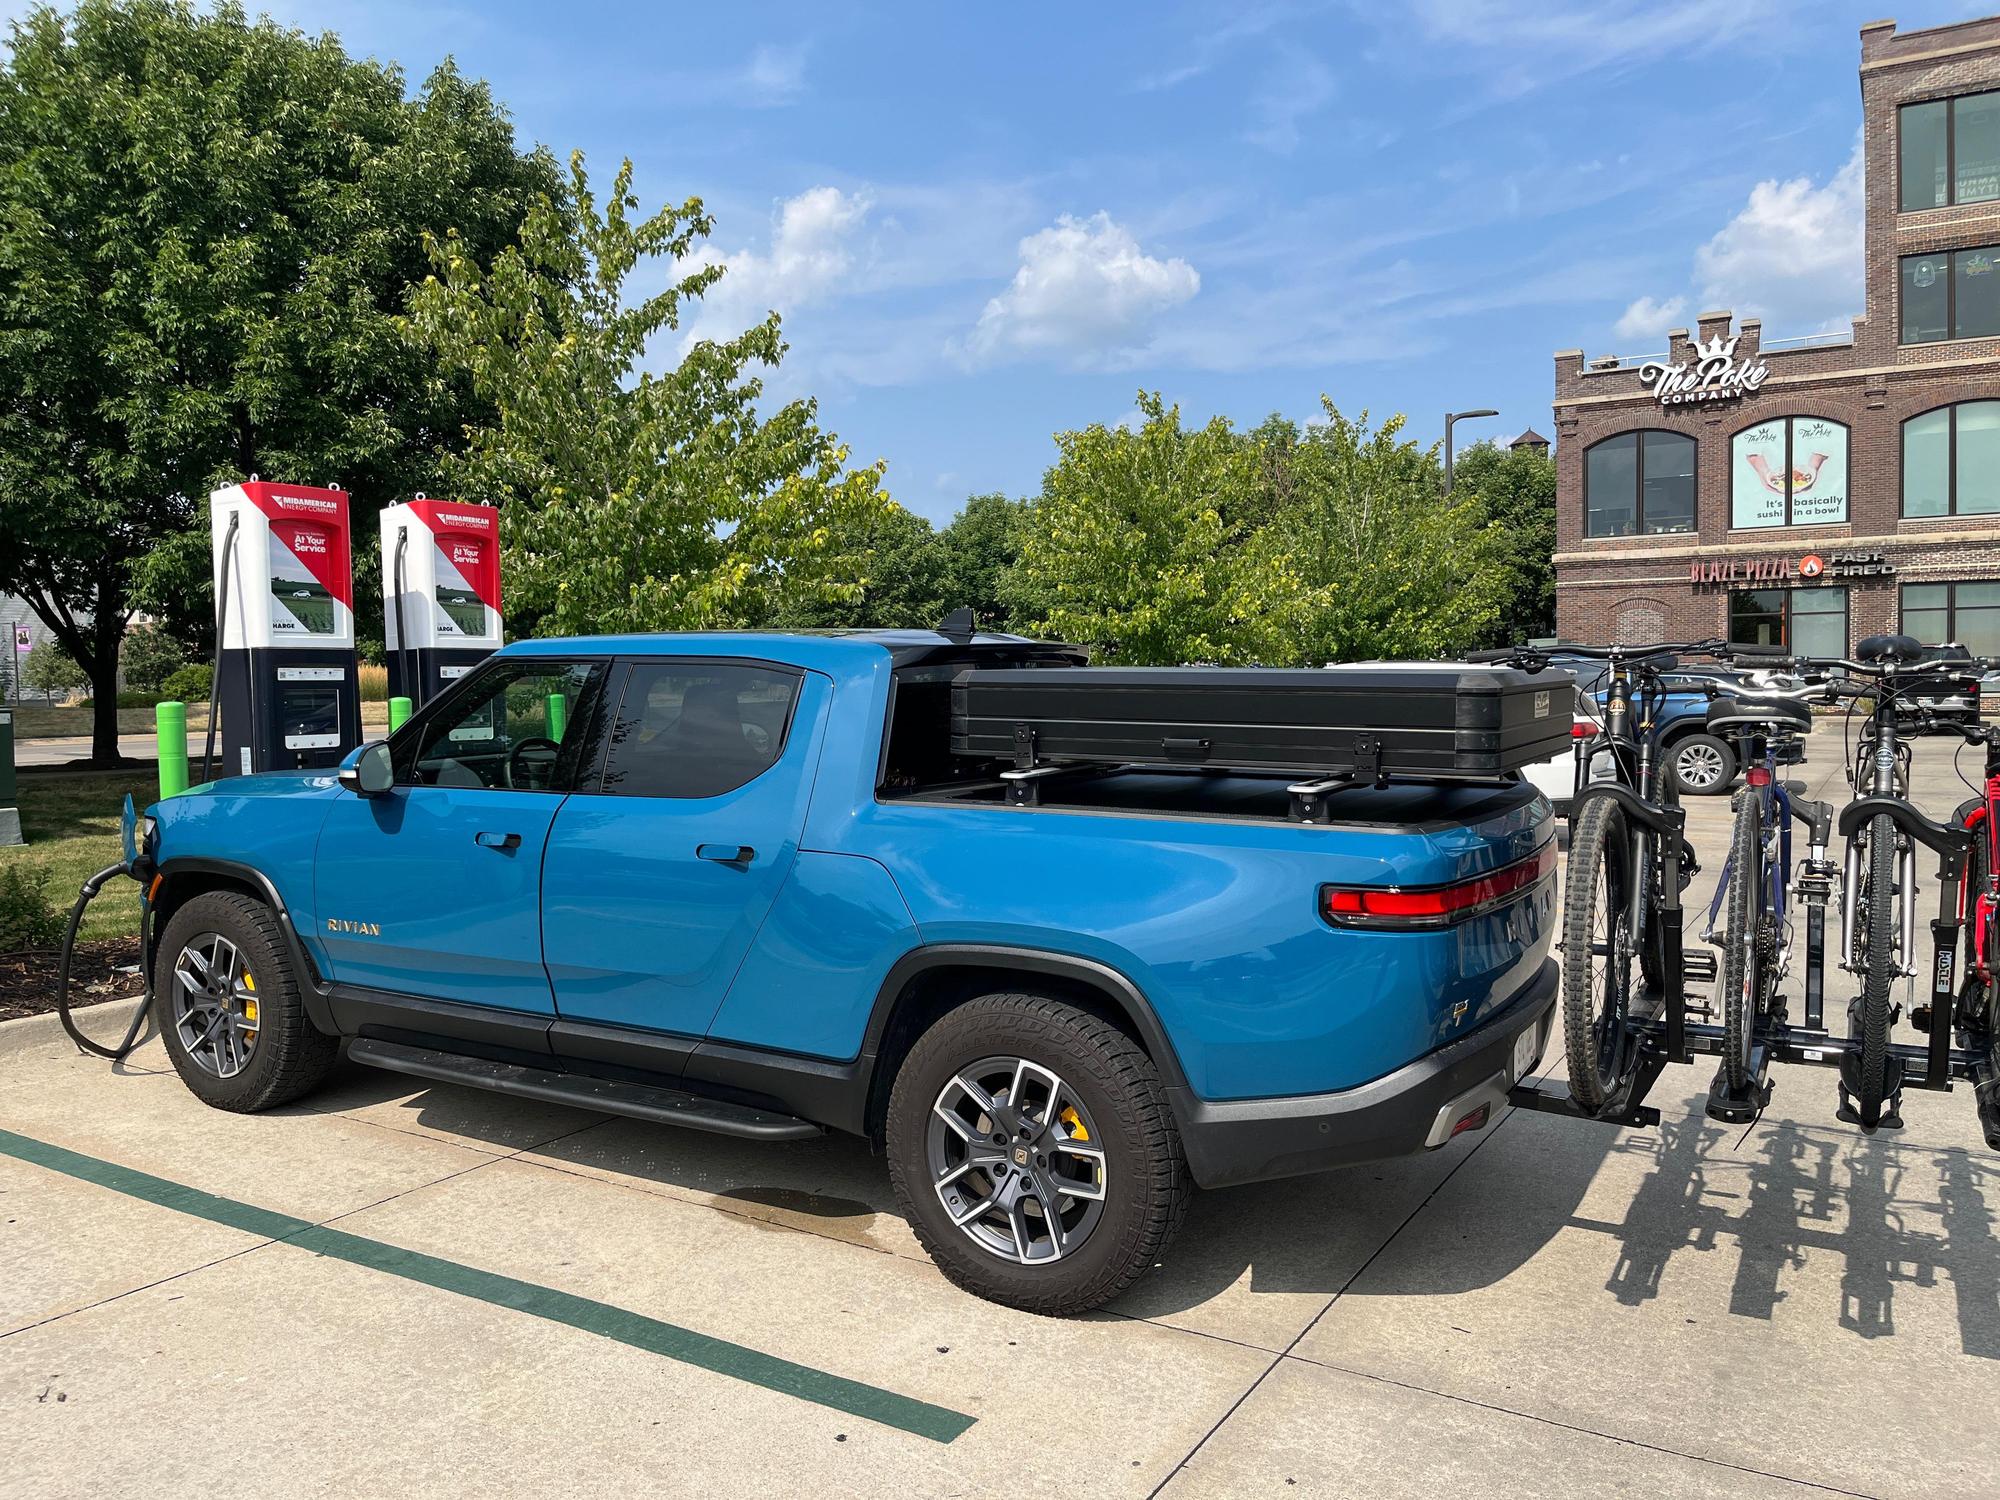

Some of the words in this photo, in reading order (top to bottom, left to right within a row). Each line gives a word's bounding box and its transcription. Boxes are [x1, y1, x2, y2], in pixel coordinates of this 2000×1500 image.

[1639, 361, 1700, 398] The
[1697, 355, 1769, 391] Poké
[1661, 388, 1743, 405] COMPANY
[282, 497, 337, 509] MIDAMERICAN
[1766, 500, 1783, 509] It's
[1794, 496, 1843, 506] basically
[308, 505, 337, 514] COMPANY
[1757, 510, 1783, 518] sushi
[1794, 508, 1803, 516] in
[1815, 506, 1840, 514] bowl
[445, 514, 490, 525] MIDAMERICAN
[465, 521, 490, 529] COMPANY
[294, 535, 305, 544] At
[306, 535, 326, 546] Your
[294, 542, 326, 553] Service
[453, 547, 462, 555] At
[463, 547, 479, 558] Your
[453, 554, 479, 564] Service
[1690, 560, 1738, 582] BLAZE
[1746, 556, 1791, 580] PIZZA
[1831, 564, 1896, 577] FIRE'D
[328, 918, 380, 936] RIVIAN
